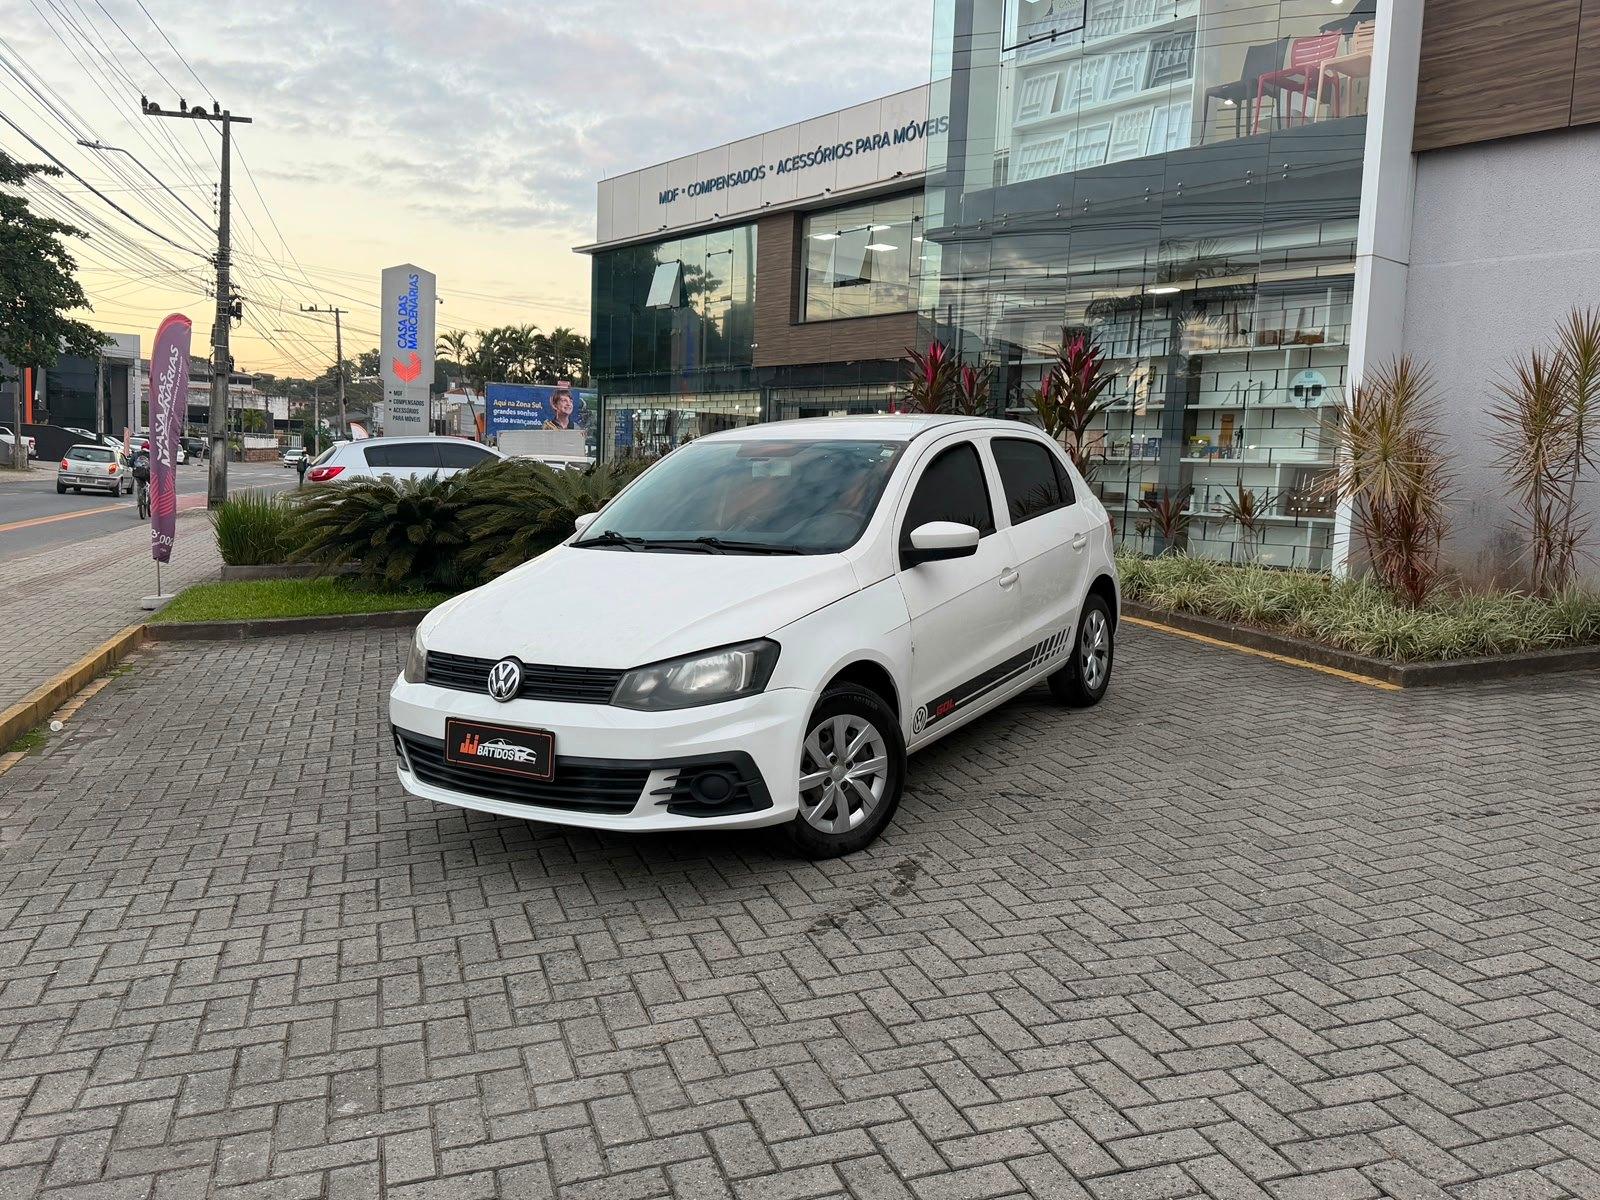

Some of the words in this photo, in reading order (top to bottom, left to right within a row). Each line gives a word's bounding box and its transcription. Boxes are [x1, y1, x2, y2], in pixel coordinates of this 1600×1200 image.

[659, 187, 679, 204] MDF
[687, 165, 766, 197] COMPENSADOS
[776, 141, 853, 175] ACESSÓRIOS
[855, 131, 891, 154] PARA
[893, 115, 949, 145] MÓVEIS
[398, 295, 409, 316] DAS
[408, 273, 419, 350] MARCENARIAS
[398, 319, 408, 349] CASA
[493, 399, 507, 407] Aqui
[516, 400, 531, 408] Zona
[532, 401, 543, 409] Sul,
[493, 408, 516, 416] grandes
[517, 409, 538, 417] sonhos
[510, 418, 543, 426] avançando.
[477, 746, 515, 761] BATIDOS
